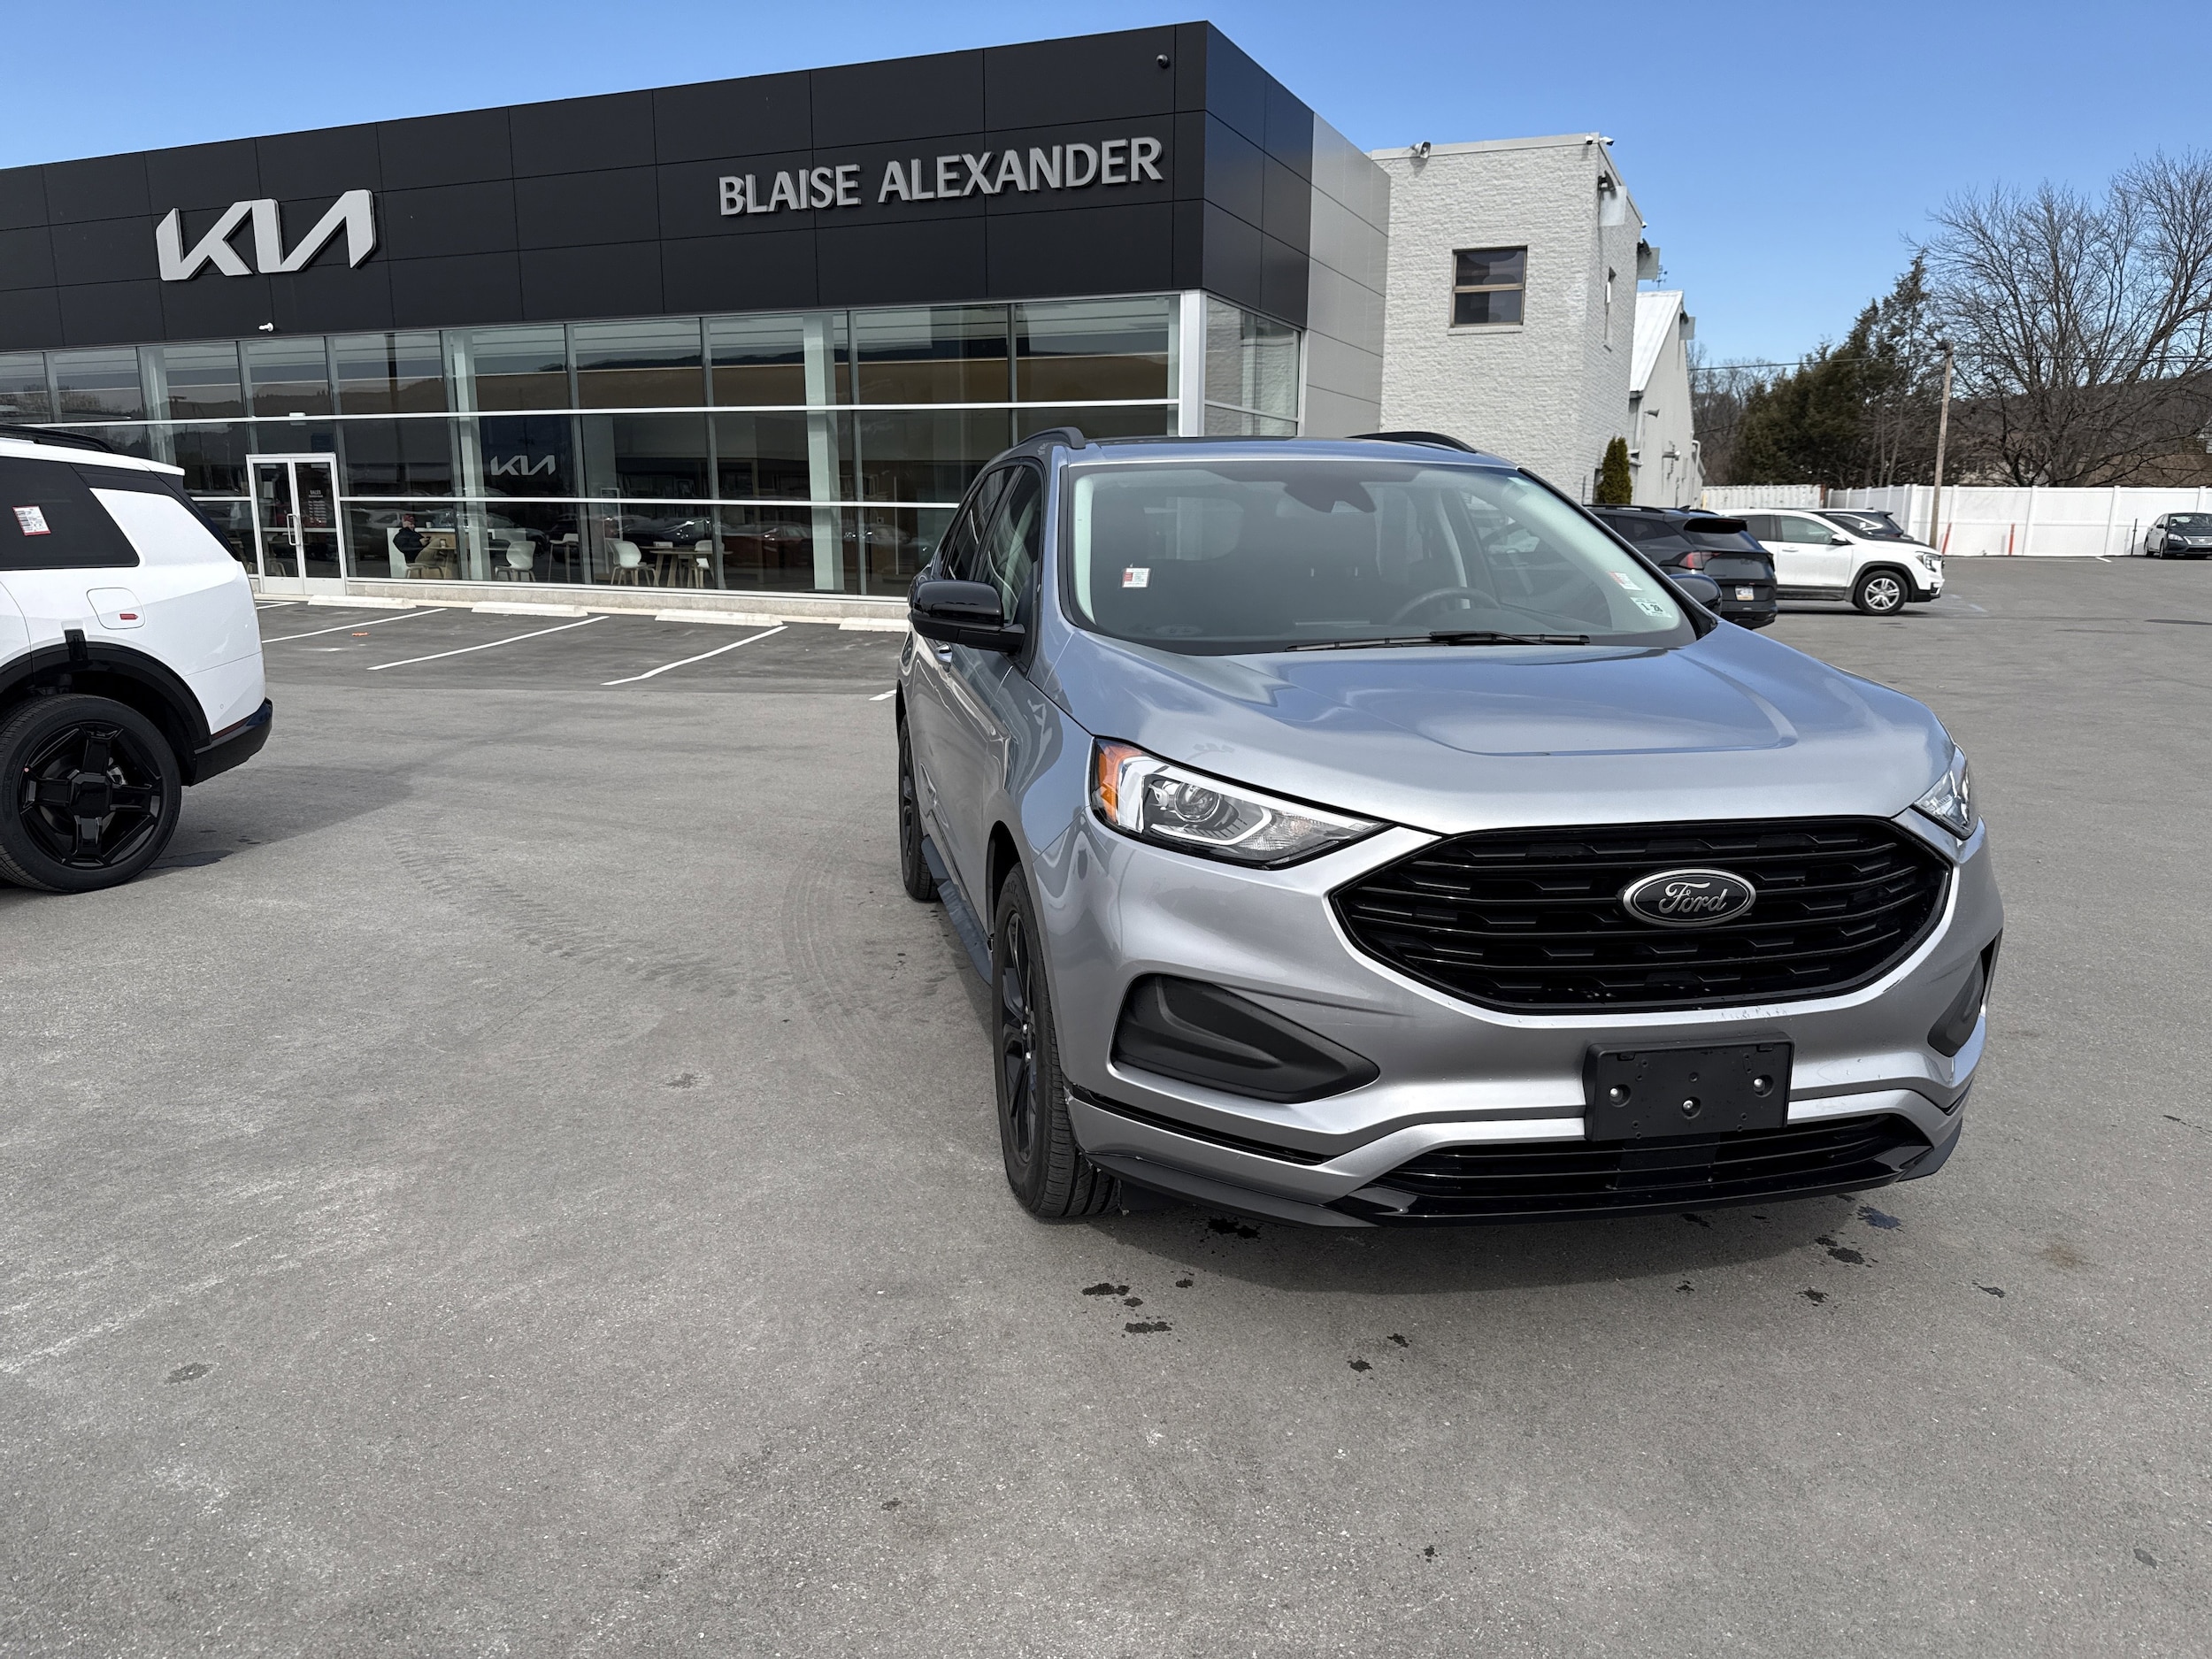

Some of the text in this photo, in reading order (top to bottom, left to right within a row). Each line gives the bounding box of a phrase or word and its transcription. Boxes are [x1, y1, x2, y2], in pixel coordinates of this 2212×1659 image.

[719, 136, 1164, 216] BLAISE ALEXANDER
[156, 189, 377, 281] KIA
[490, 454, 556, 476] KIA
[1658, 881, 1729, 914] Ford
